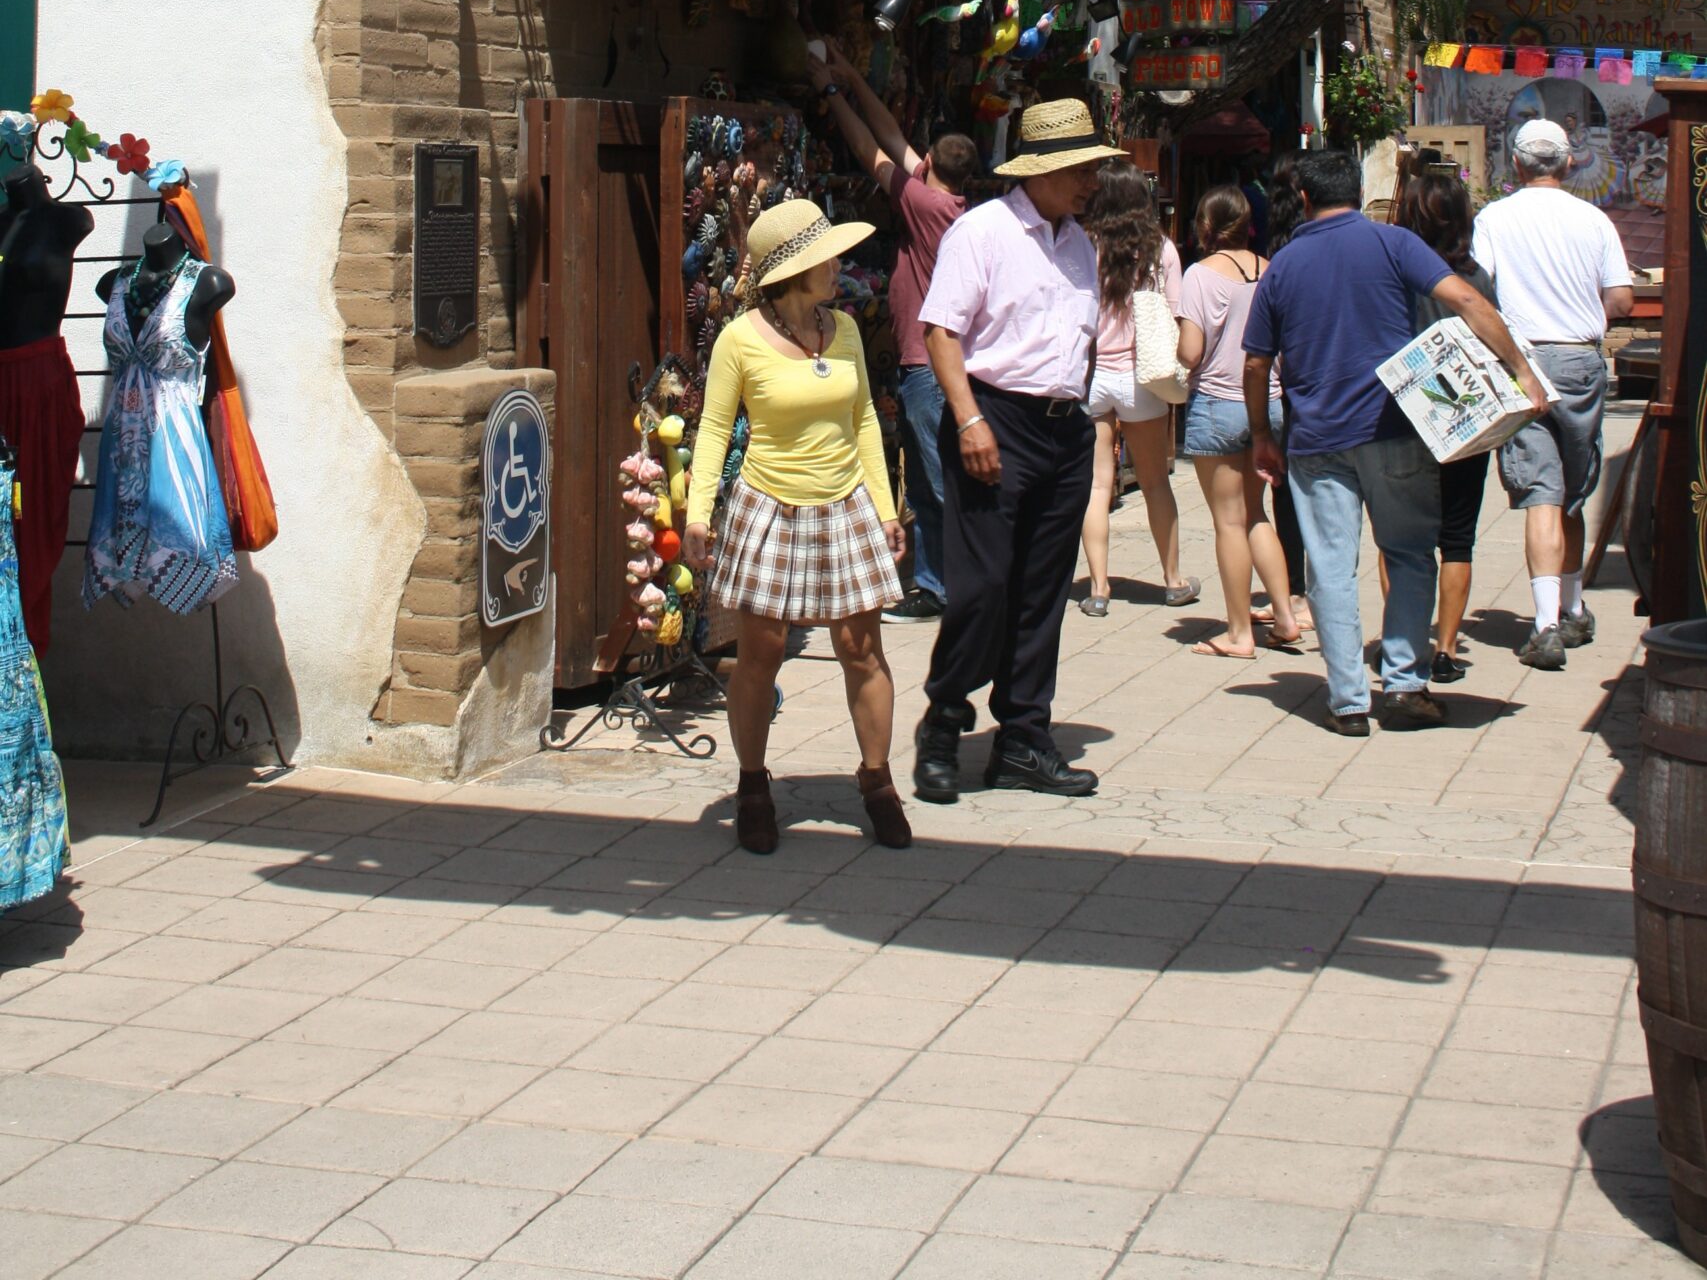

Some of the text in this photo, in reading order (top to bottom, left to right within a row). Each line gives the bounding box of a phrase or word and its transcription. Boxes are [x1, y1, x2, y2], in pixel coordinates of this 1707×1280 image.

[1123, 5, 1162, 33] OLD
[1134, 53, 1222, 82] PHOTO
[1431, 331, 1498, 422] DCKWALL
